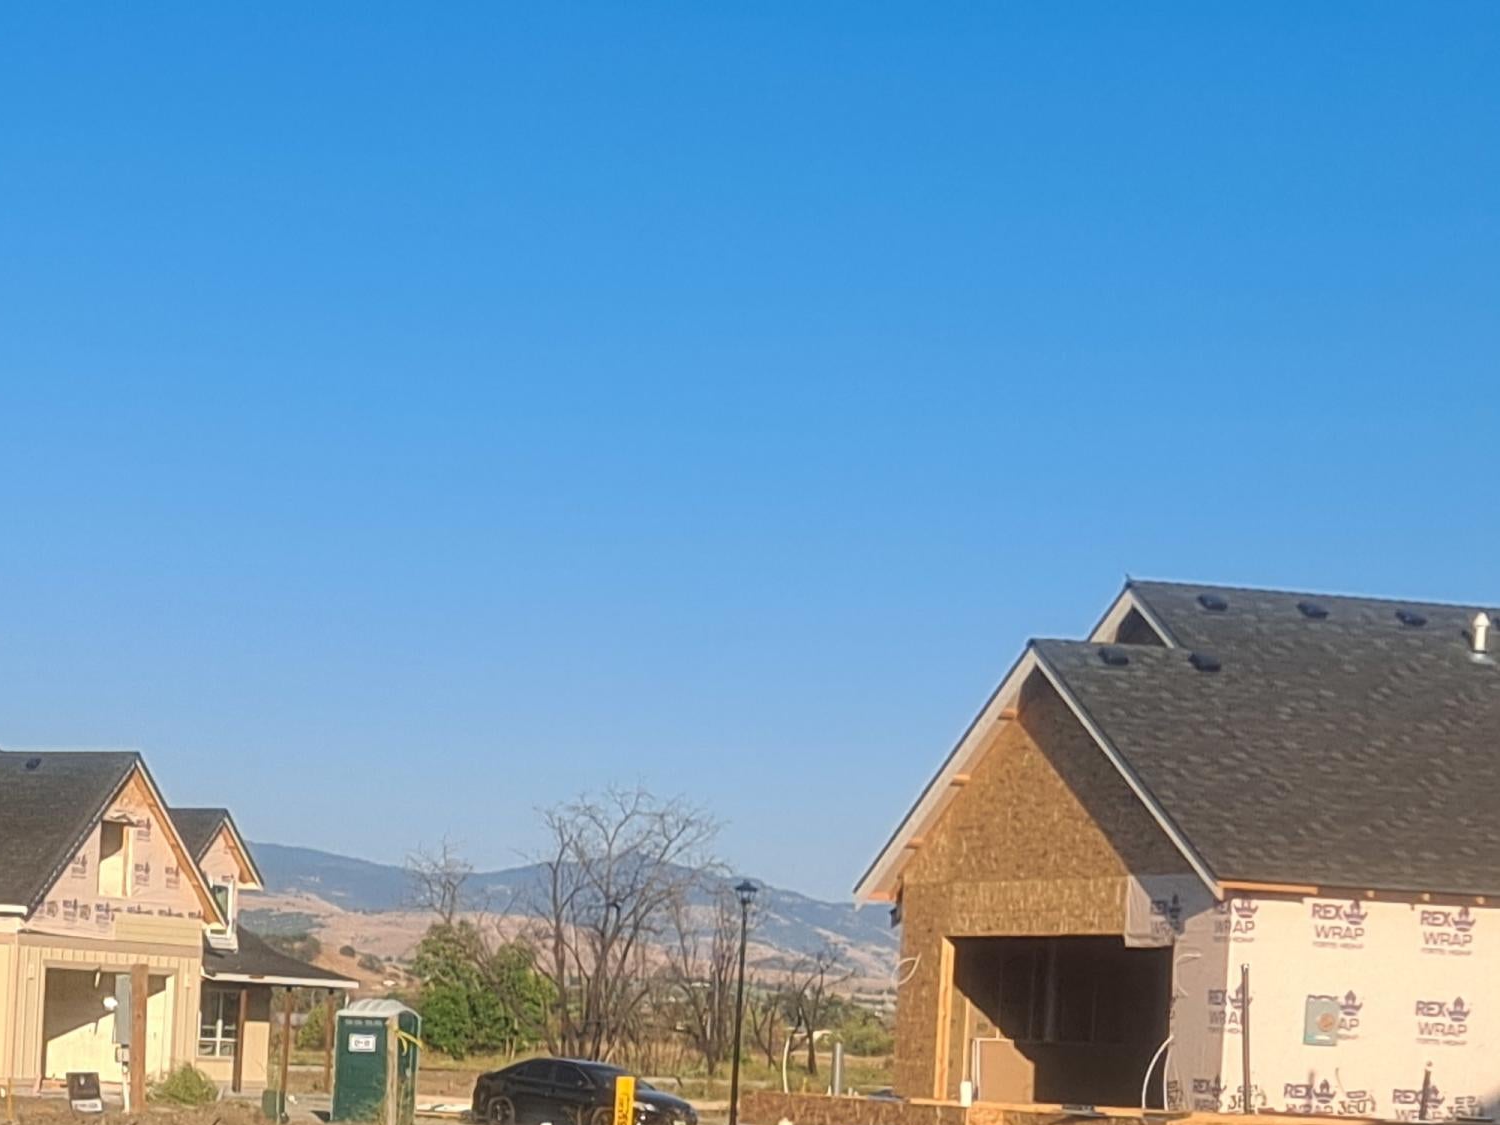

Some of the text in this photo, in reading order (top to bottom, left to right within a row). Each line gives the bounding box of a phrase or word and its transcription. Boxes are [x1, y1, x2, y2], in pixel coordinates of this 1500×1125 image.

[1312, 903, 1343, 920] REX
[1420, 910, 1453, 927] REX
[1315, 924, 1365, 940] WRAP
[1423, 931, 1473, 947] WRAP
[1415, 1000, 1447, 1018] REX
[1418, 1021, 1468, 1037] WRAP
